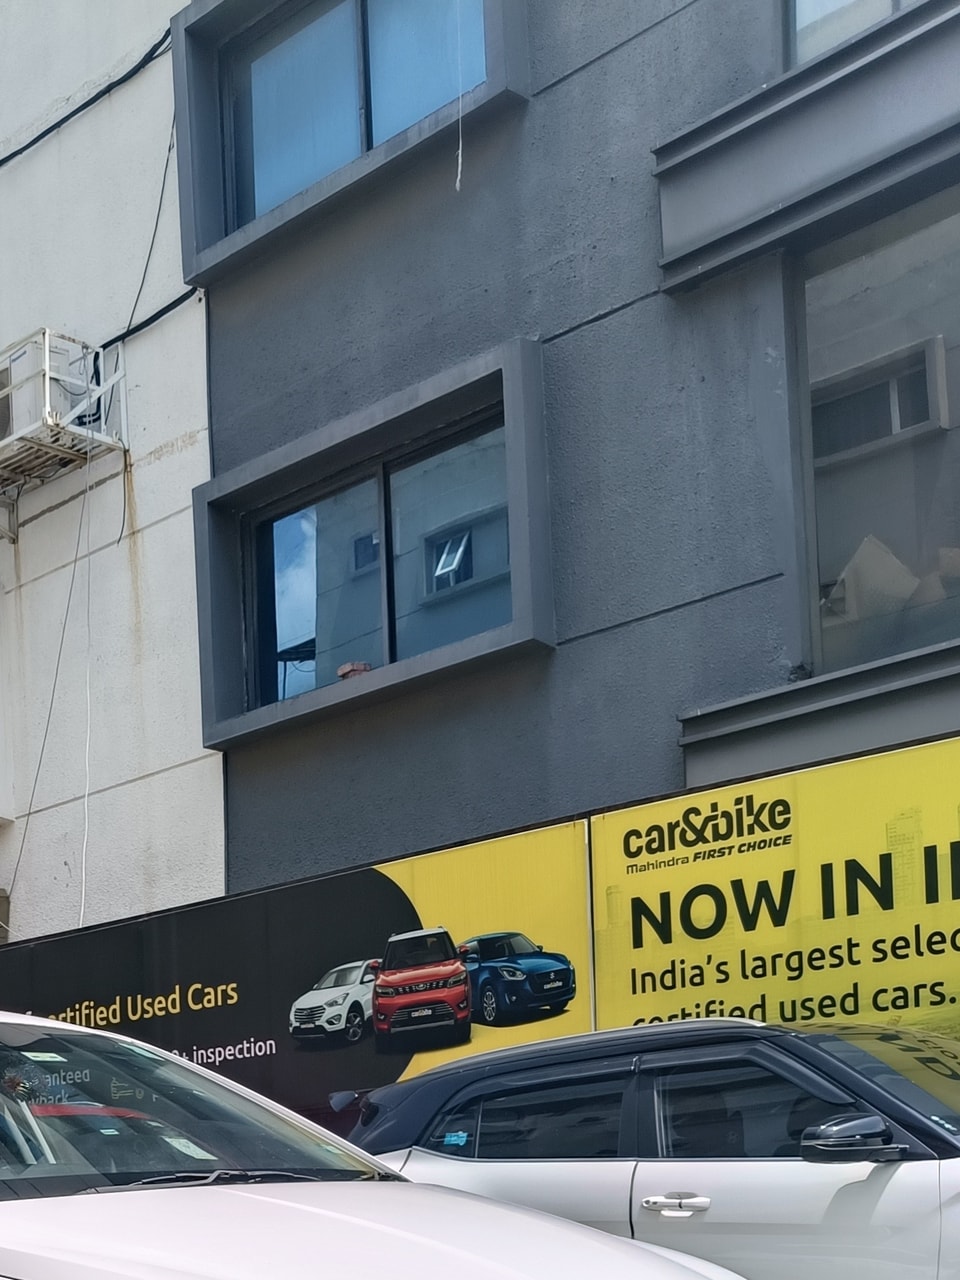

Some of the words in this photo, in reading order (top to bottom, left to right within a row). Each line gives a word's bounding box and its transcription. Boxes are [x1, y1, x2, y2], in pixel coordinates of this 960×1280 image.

[623, 795, 792, 859] car&bike
[626, 856, 689, 875] Mahindra
[693, 846, 734, 862] FIRST
[738, 835, 792, 854] CHOICE
[631, 869, 796, 949] NOW
[820, 853, 894, 920] IN
[924, 841, 960, 904] I
[631, 954, 730, 995] India's
[740, 937, 861, 981] largest
[127, 985, 181, 1021] Used
[187, 982, 238, 1010] Cars
[778, 982, 860, 1023] used
[871, 981, 957, 1012] cars.
[192, 1037, 276, 1065] inspection
